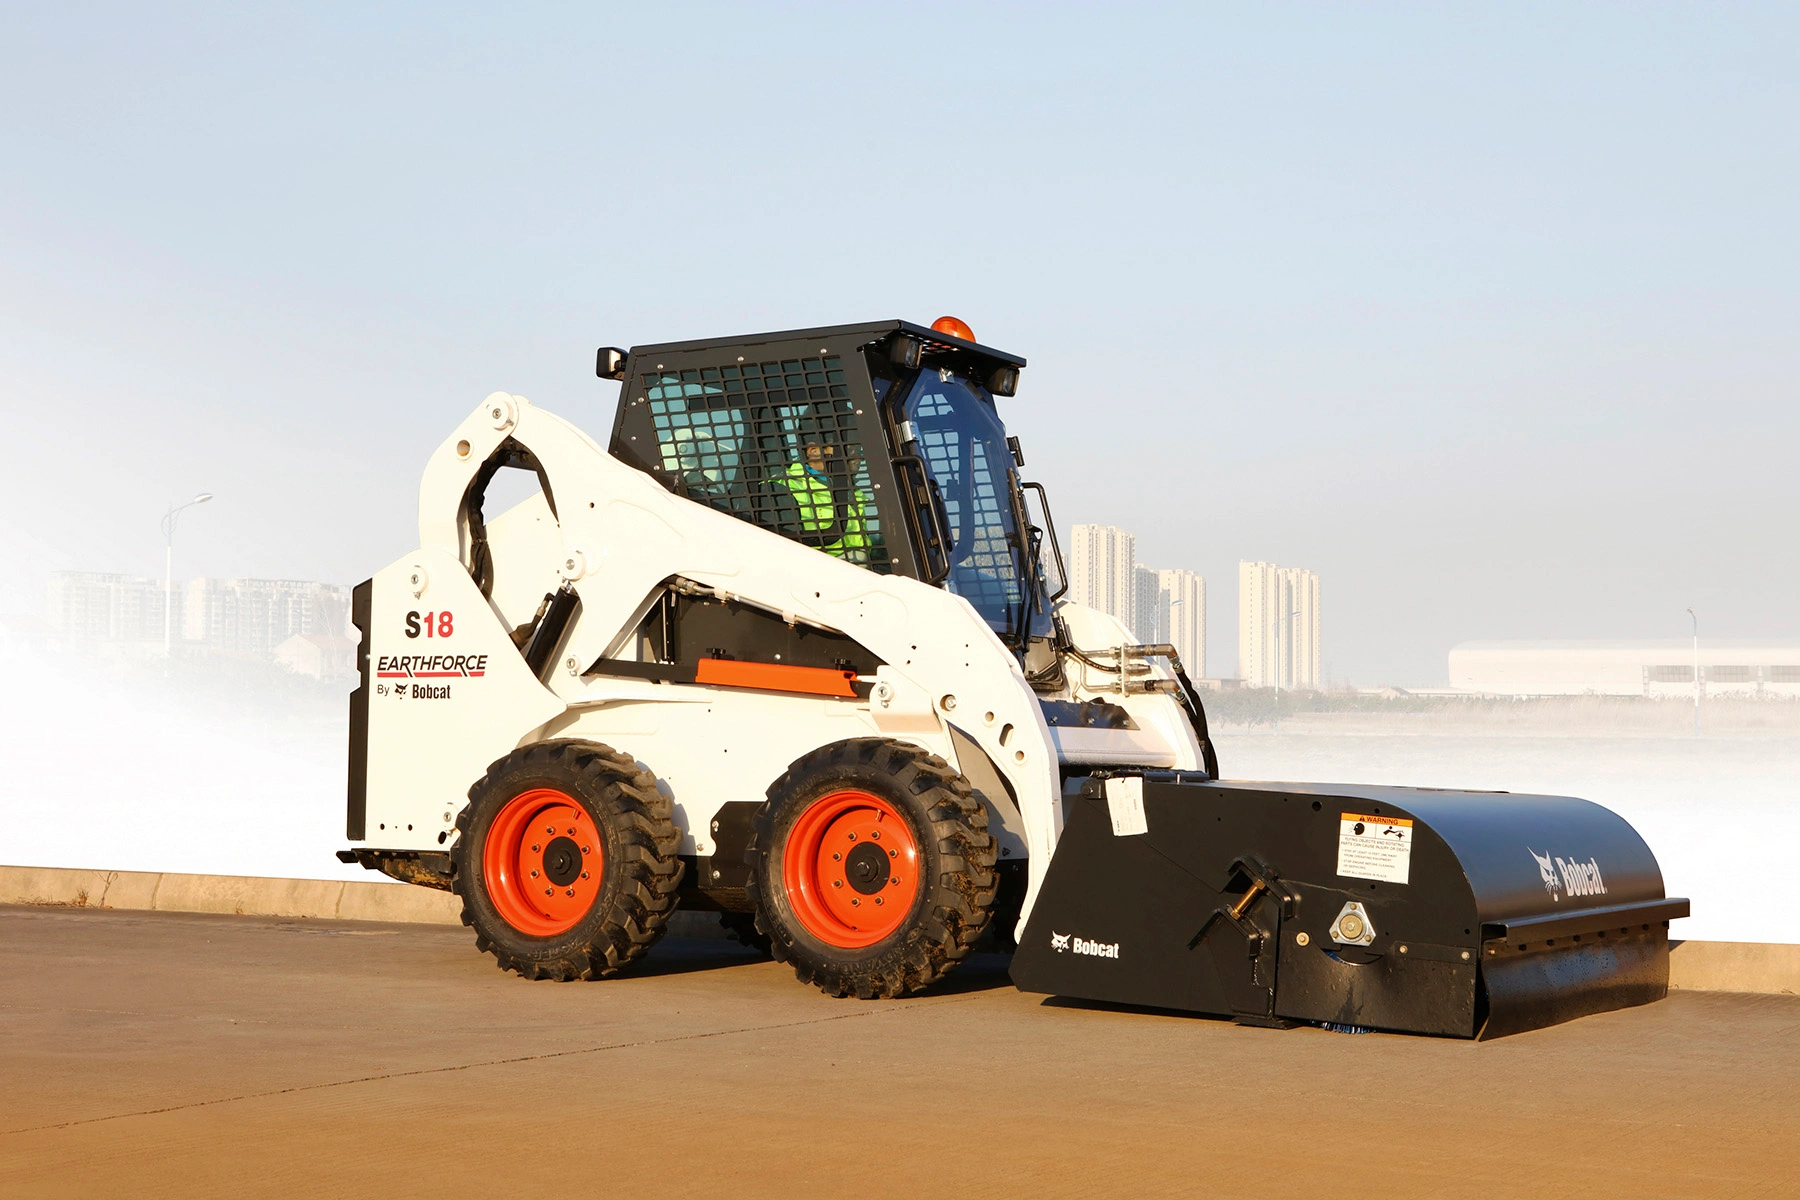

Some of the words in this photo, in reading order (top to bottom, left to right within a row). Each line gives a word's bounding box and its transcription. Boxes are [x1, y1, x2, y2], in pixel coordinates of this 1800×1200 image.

[404, 610, 454, 638] S18
[378, 655, 488, 677] EARTHFORCE
[377, 685, 390, 696] By
[412, 684, 451, 699] Bobcat
[1366, 816, 1398, 825] WARNING
[1554, 857, 1606, 896] Bobcat
[1073, 937, 1120, 959] Bobcat
